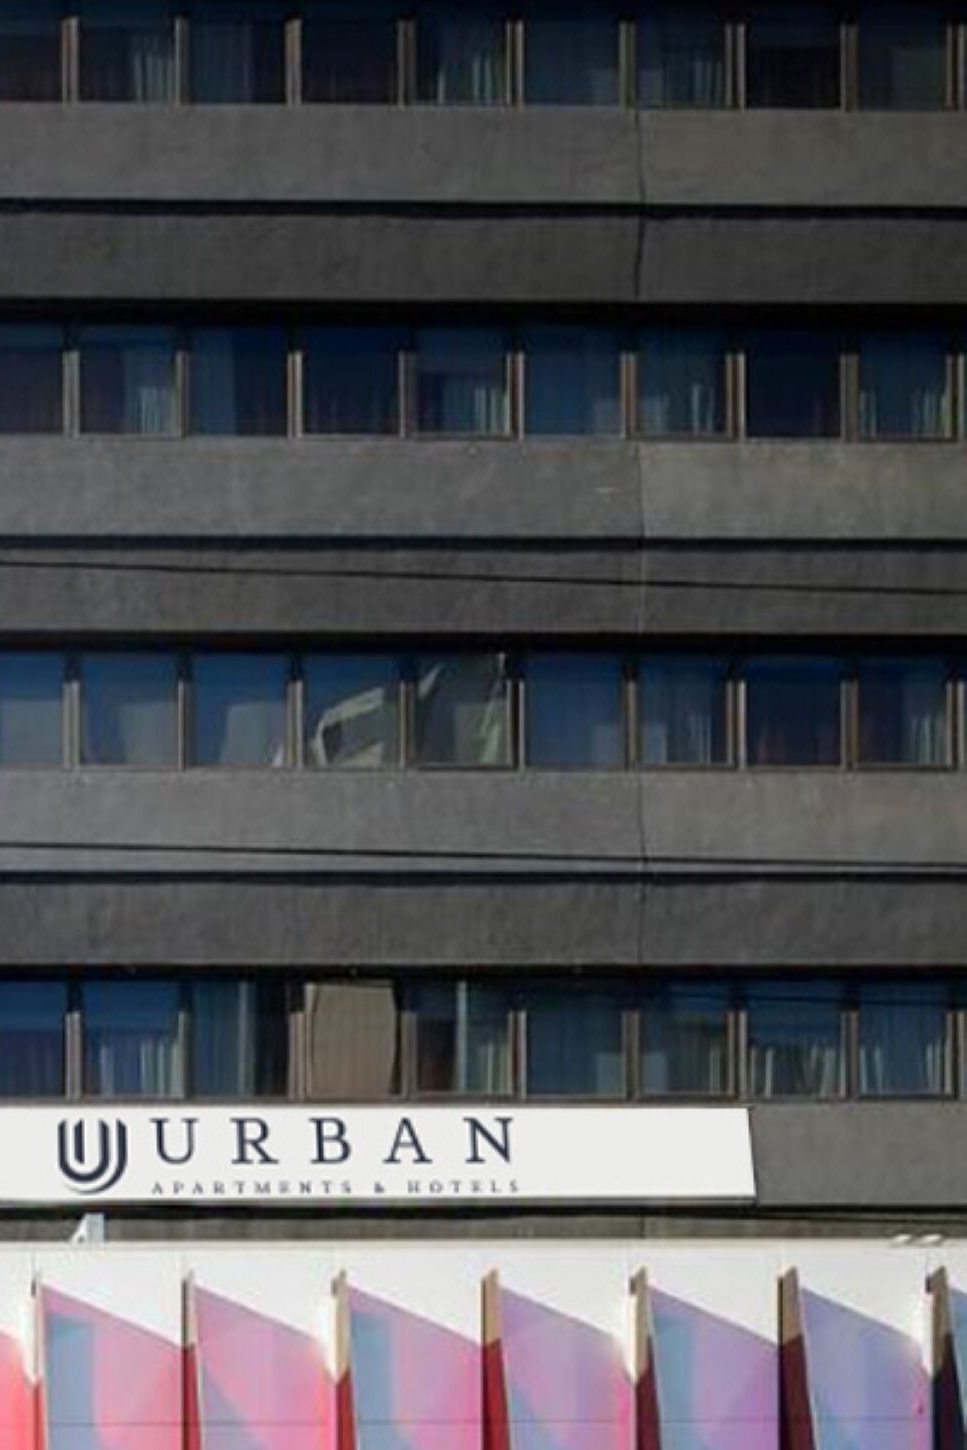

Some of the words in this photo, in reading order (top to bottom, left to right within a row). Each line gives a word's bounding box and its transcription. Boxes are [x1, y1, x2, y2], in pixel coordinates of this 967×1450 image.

[151, 1116, 515, 1165] URBAN
[152, 1180, 353, 1195] APARTMENTS
[373, 1182, 386, 1194] &
[408, 1179, 519, 1194] HOTELS
